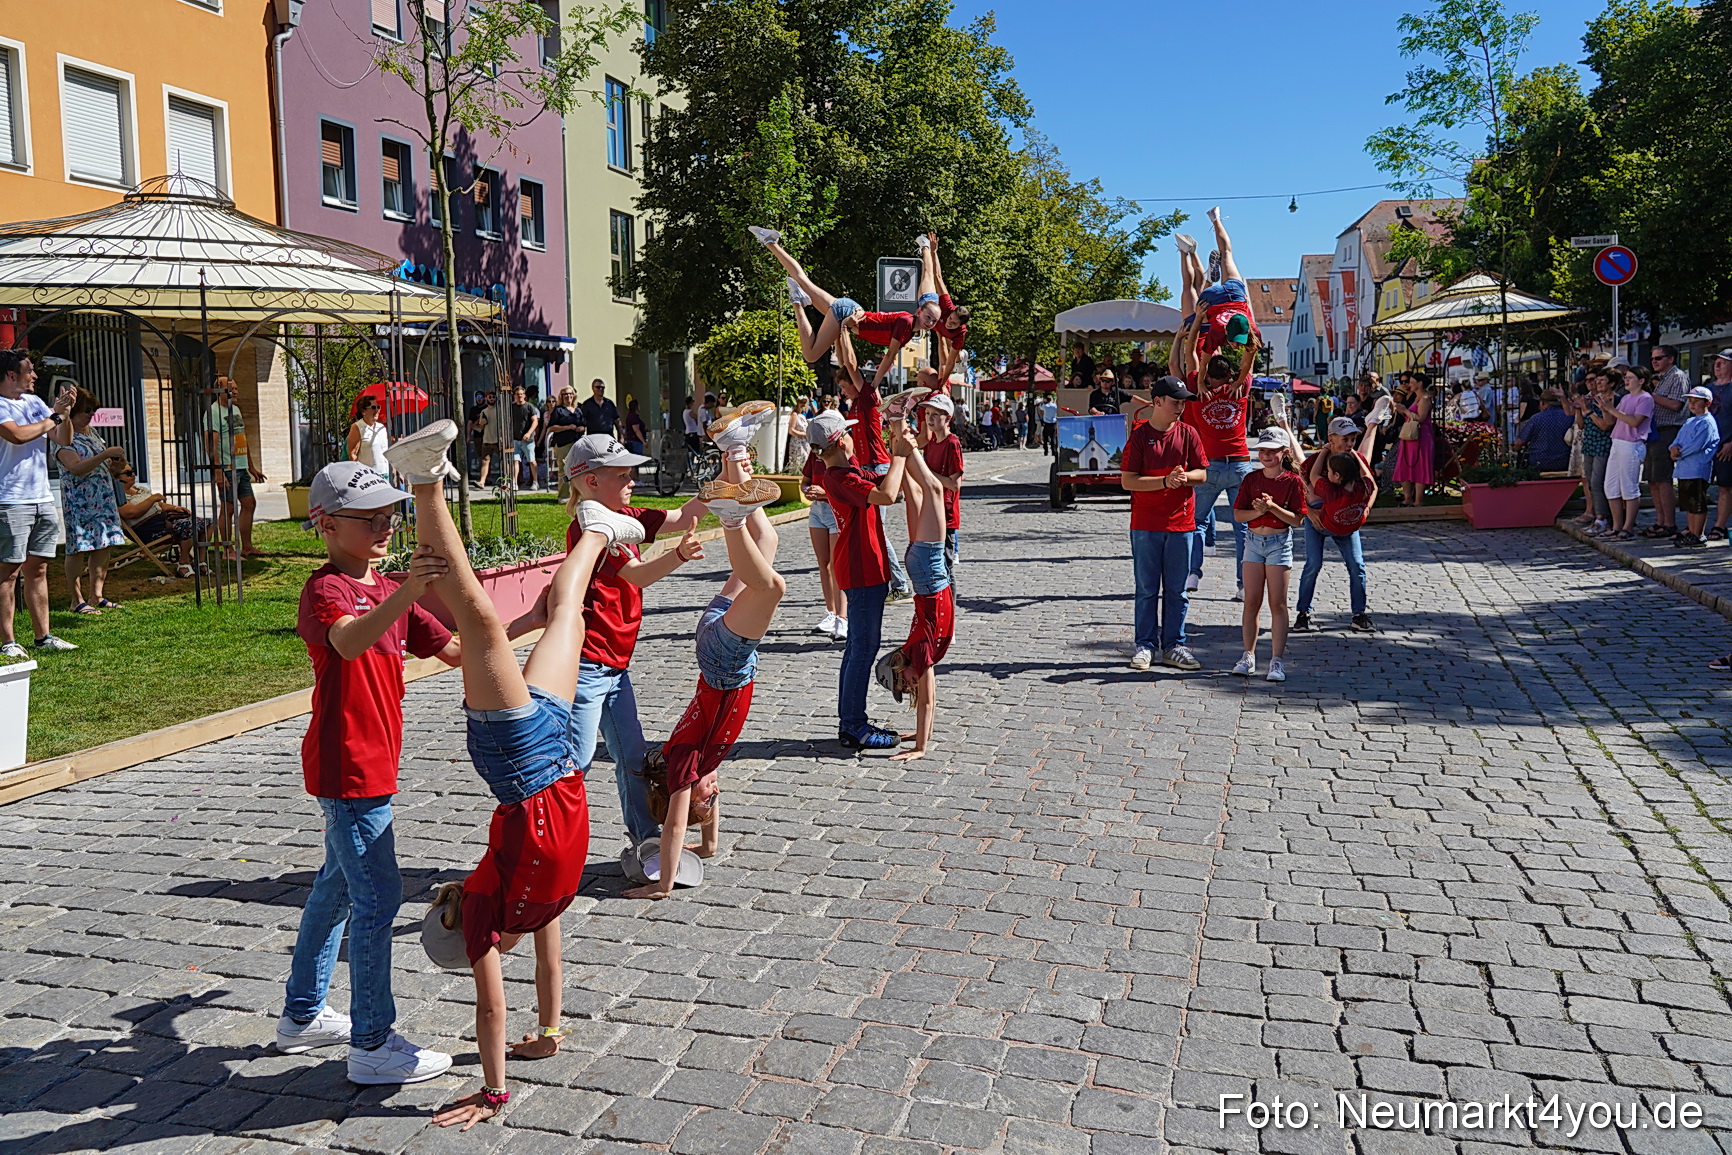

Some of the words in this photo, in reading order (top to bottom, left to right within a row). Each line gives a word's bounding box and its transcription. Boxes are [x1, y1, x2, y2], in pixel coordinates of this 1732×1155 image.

[1344, 291, 1357, 324] SALE
[515, 885, 531, 915] ROCK
[537, 797, 545, 837] ROLL
